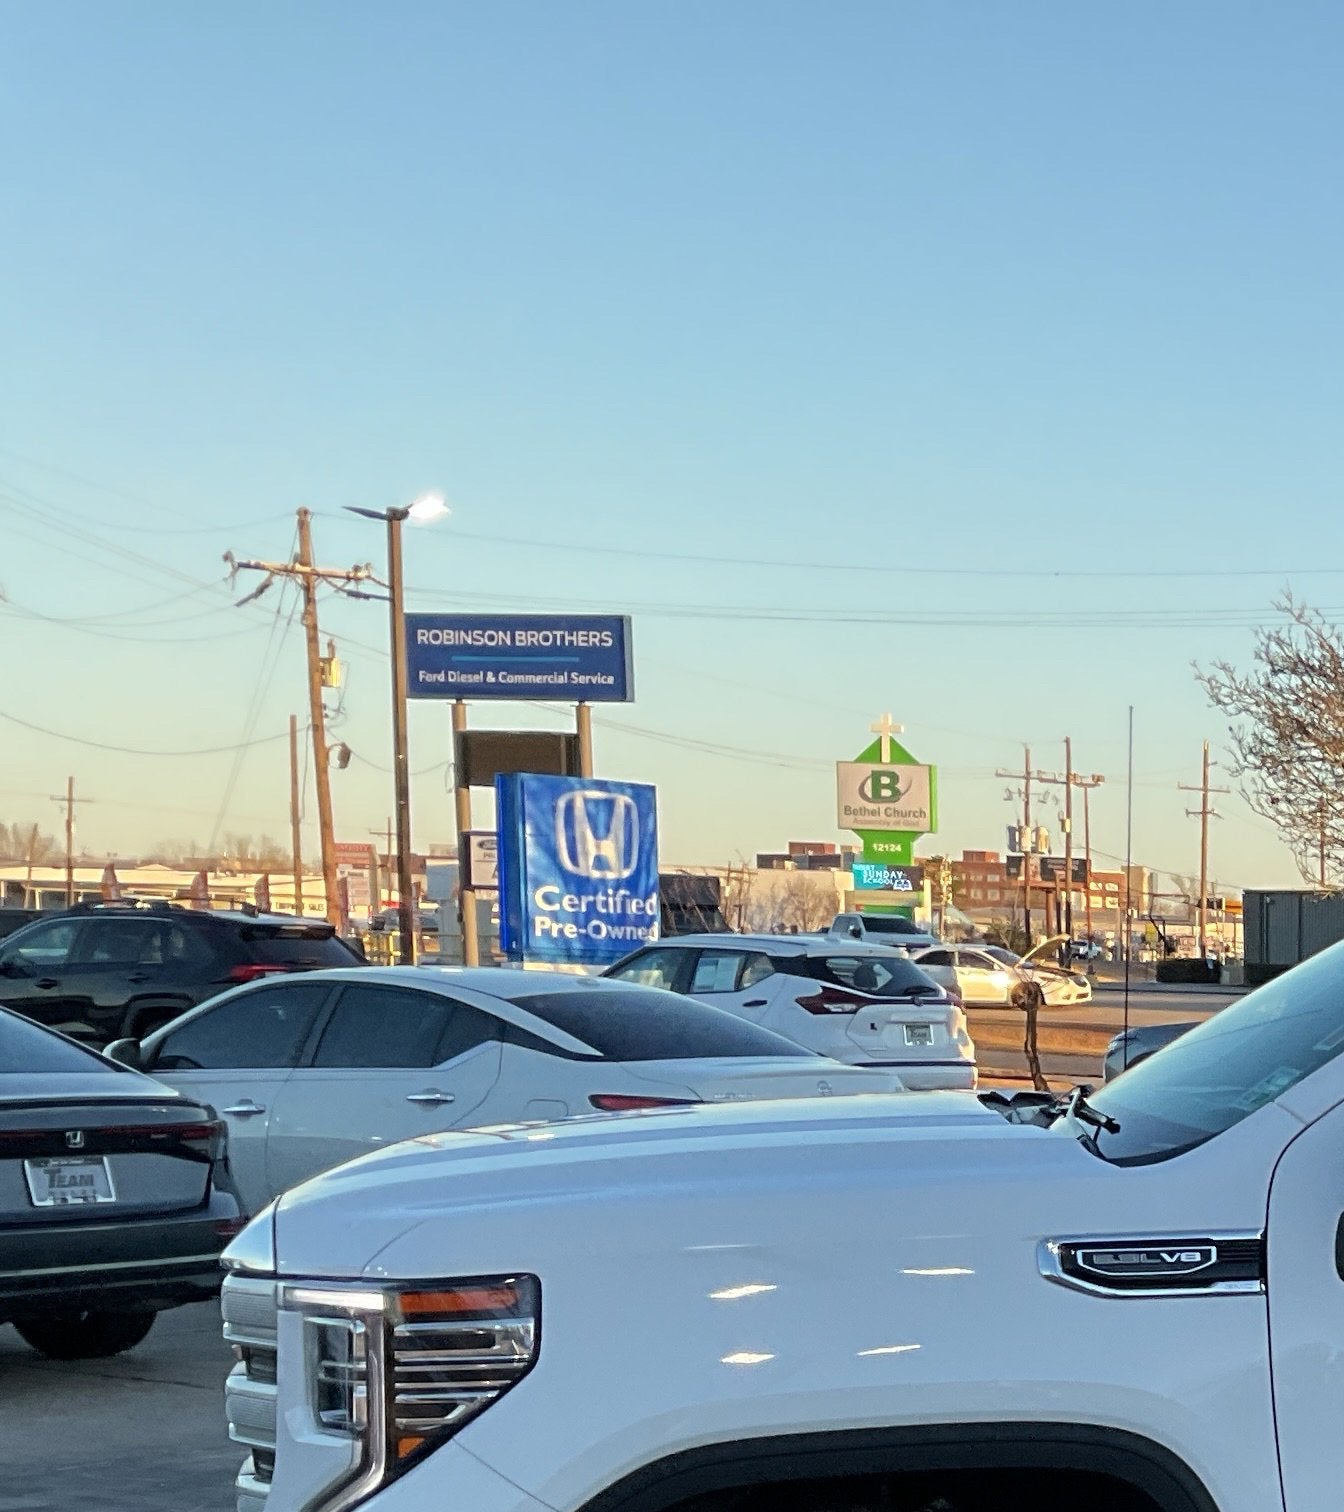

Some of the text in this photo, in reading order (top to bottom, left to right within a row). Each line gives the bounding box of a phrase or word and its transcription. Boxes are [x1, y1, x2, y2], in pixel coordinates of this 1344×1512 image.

[416, 629, 613, 647] ROBINSON BROTHERS
[418, 670, 615, 685] Ford Diesel & Commercial Service
[870, 770, 900, 801] B
[843, 805, 927, 818] Bethel Church
[873, 843, 902, 852] 12124
[863, 870, 903, 879] SUNDAY
[534, 885, 657, 915] Certified
[534, 916, 659, 942] Pre-Owned
[1160, 1252, 1201, 1262] V8
